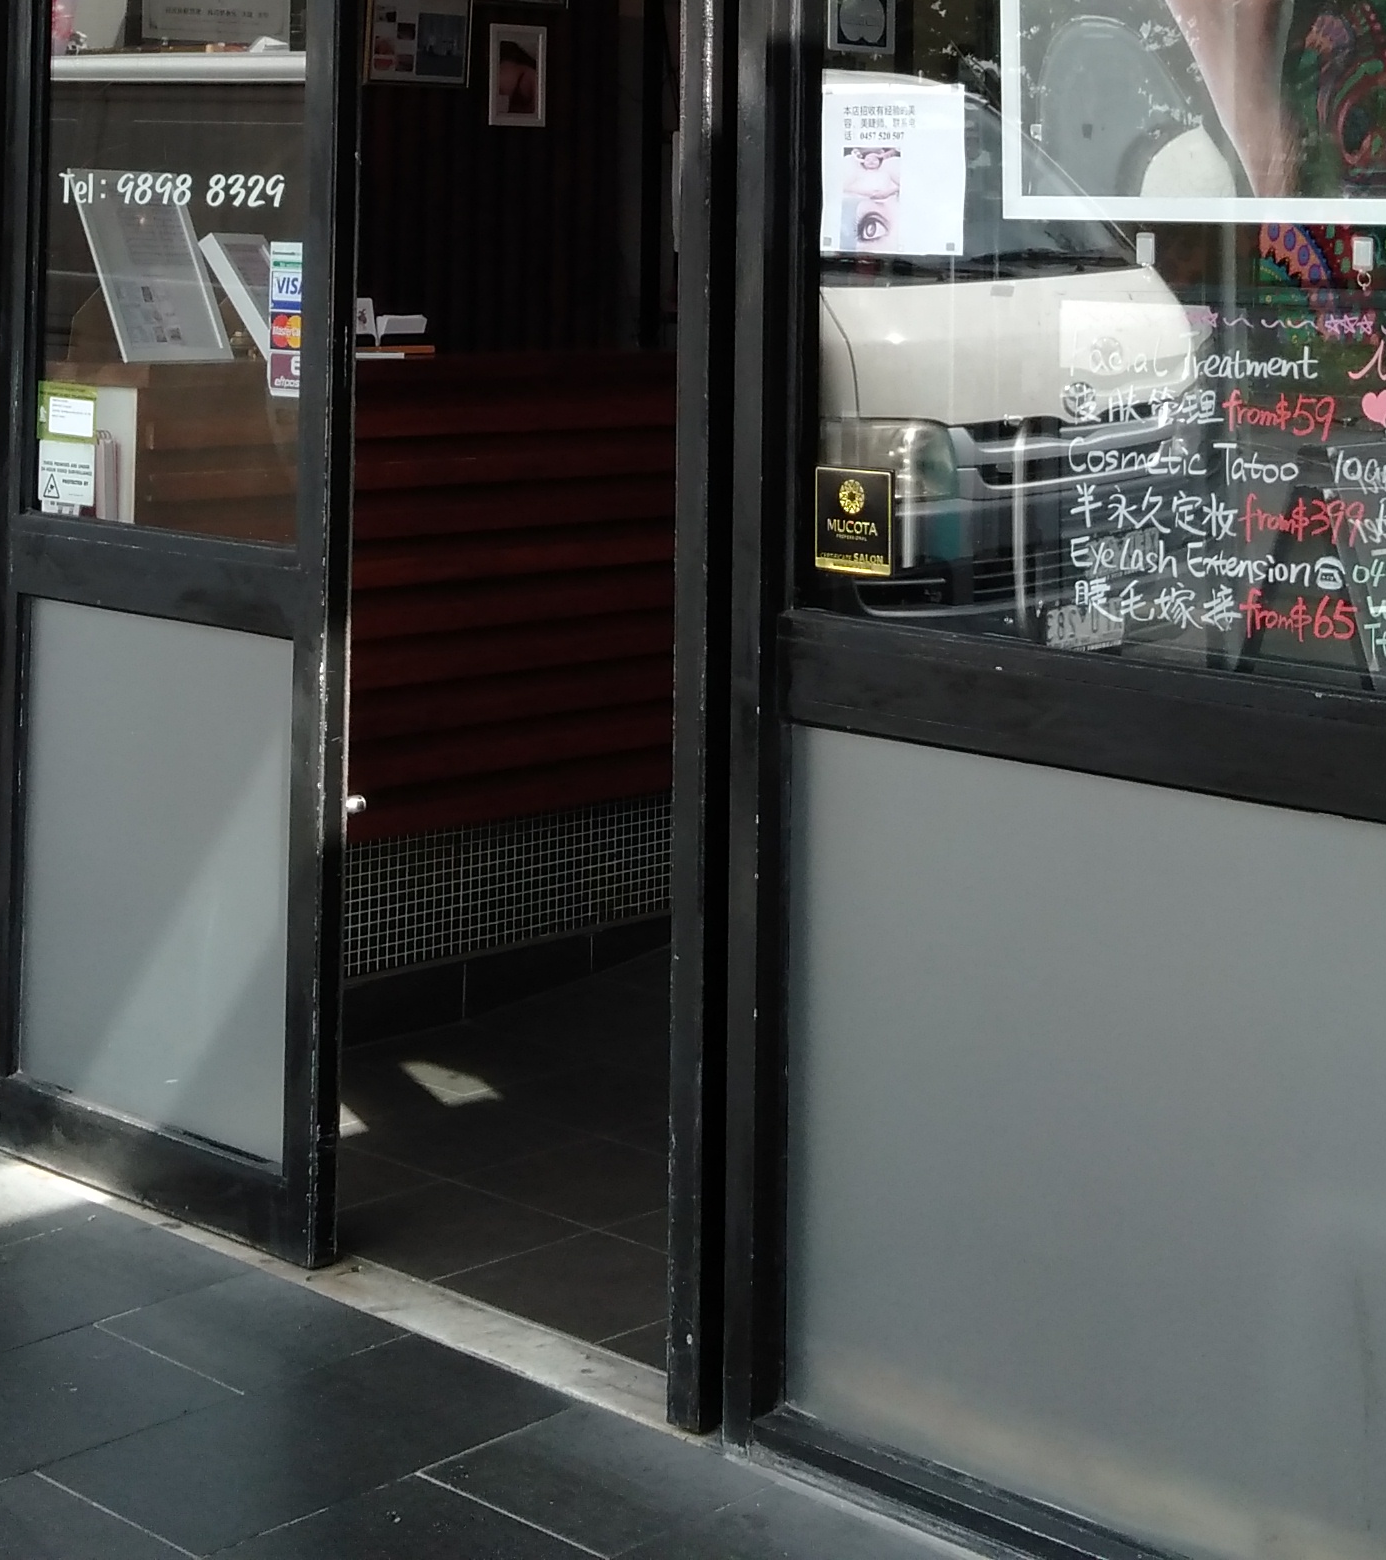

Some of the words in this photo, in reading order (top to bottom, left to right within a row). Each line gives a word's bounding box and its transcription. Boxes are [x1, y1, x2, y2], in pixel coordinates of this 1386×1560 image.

[860, 132, 876, 140] 0457
[878, 132, 890, 140] 520
[117, 172, 192, 206] 9898
[206, 173, 286, 208] 8329
[1181, 332, 1319, 382] Treatment
[1069, 437, 1207, 477] Cosmetic
[1213, 442, 1300, 484] Tatoo
[827, 518, 878, 537] MUCOTA
[853, 552, 884, 565] SALON
[1187, 541, 1310, 586] Extension
